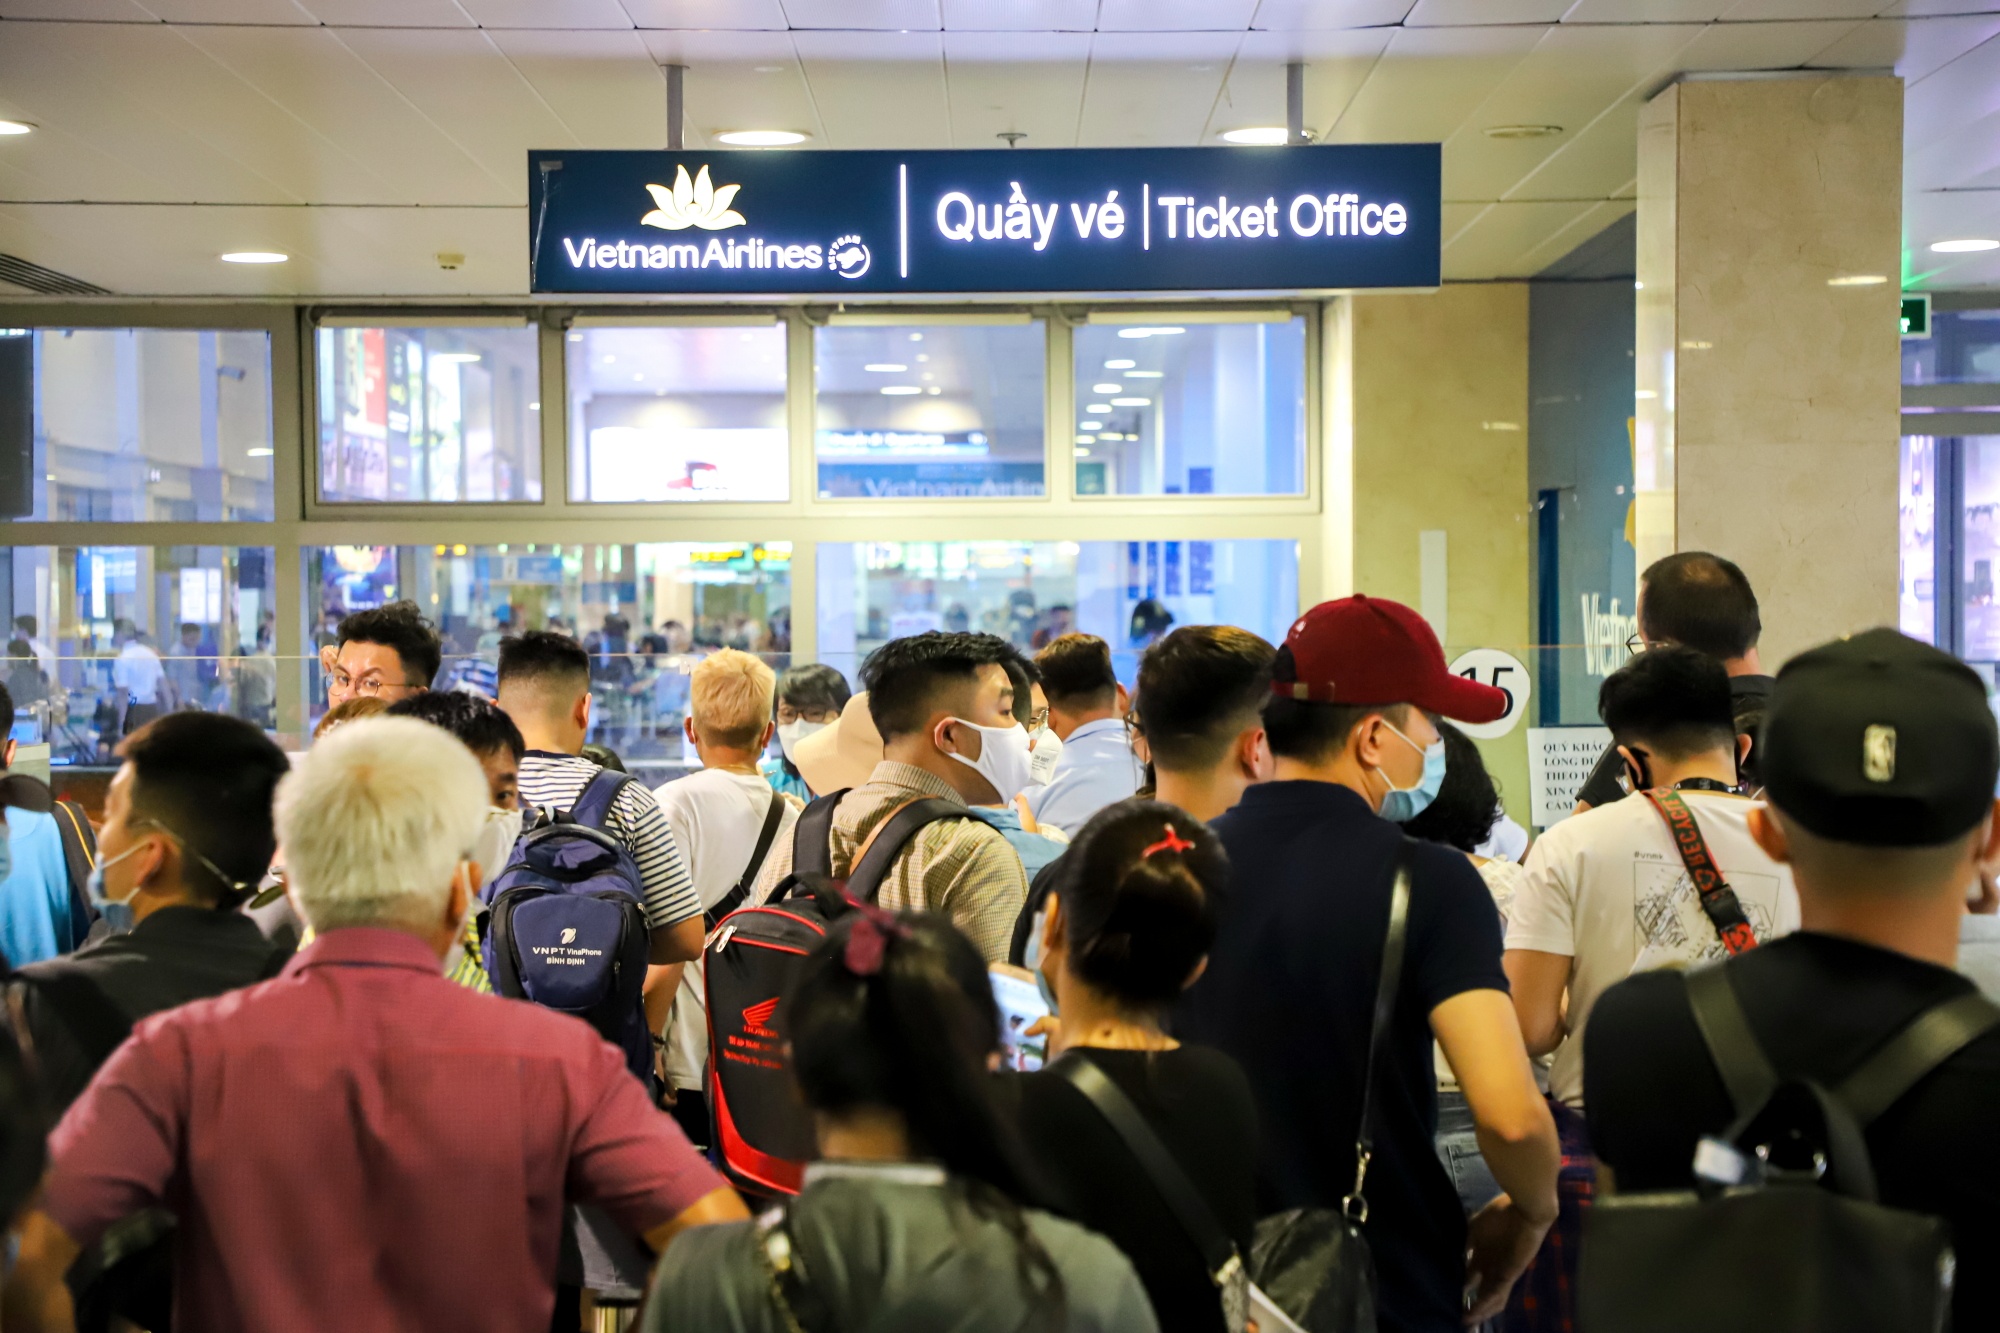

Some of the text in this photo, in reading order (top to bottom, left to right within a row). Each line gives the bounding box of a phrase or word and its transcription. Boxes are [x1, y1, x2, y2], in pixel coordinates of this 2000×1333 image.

[936, 181, 1126, 252] Quầy vé
[1157, 193, 1408, 239] Ticket Office
[563, 237, 823, 269] Vietnam Airlines
[1543, 740, 1608, 754] QUÝ KHÁC
[1545, 771, 1578, 781] THEO
[1546, 787, 1566, 796] XIN
[532, 946, 565, 955] VNPT
[546, 956, 565, 965] BÌNH
